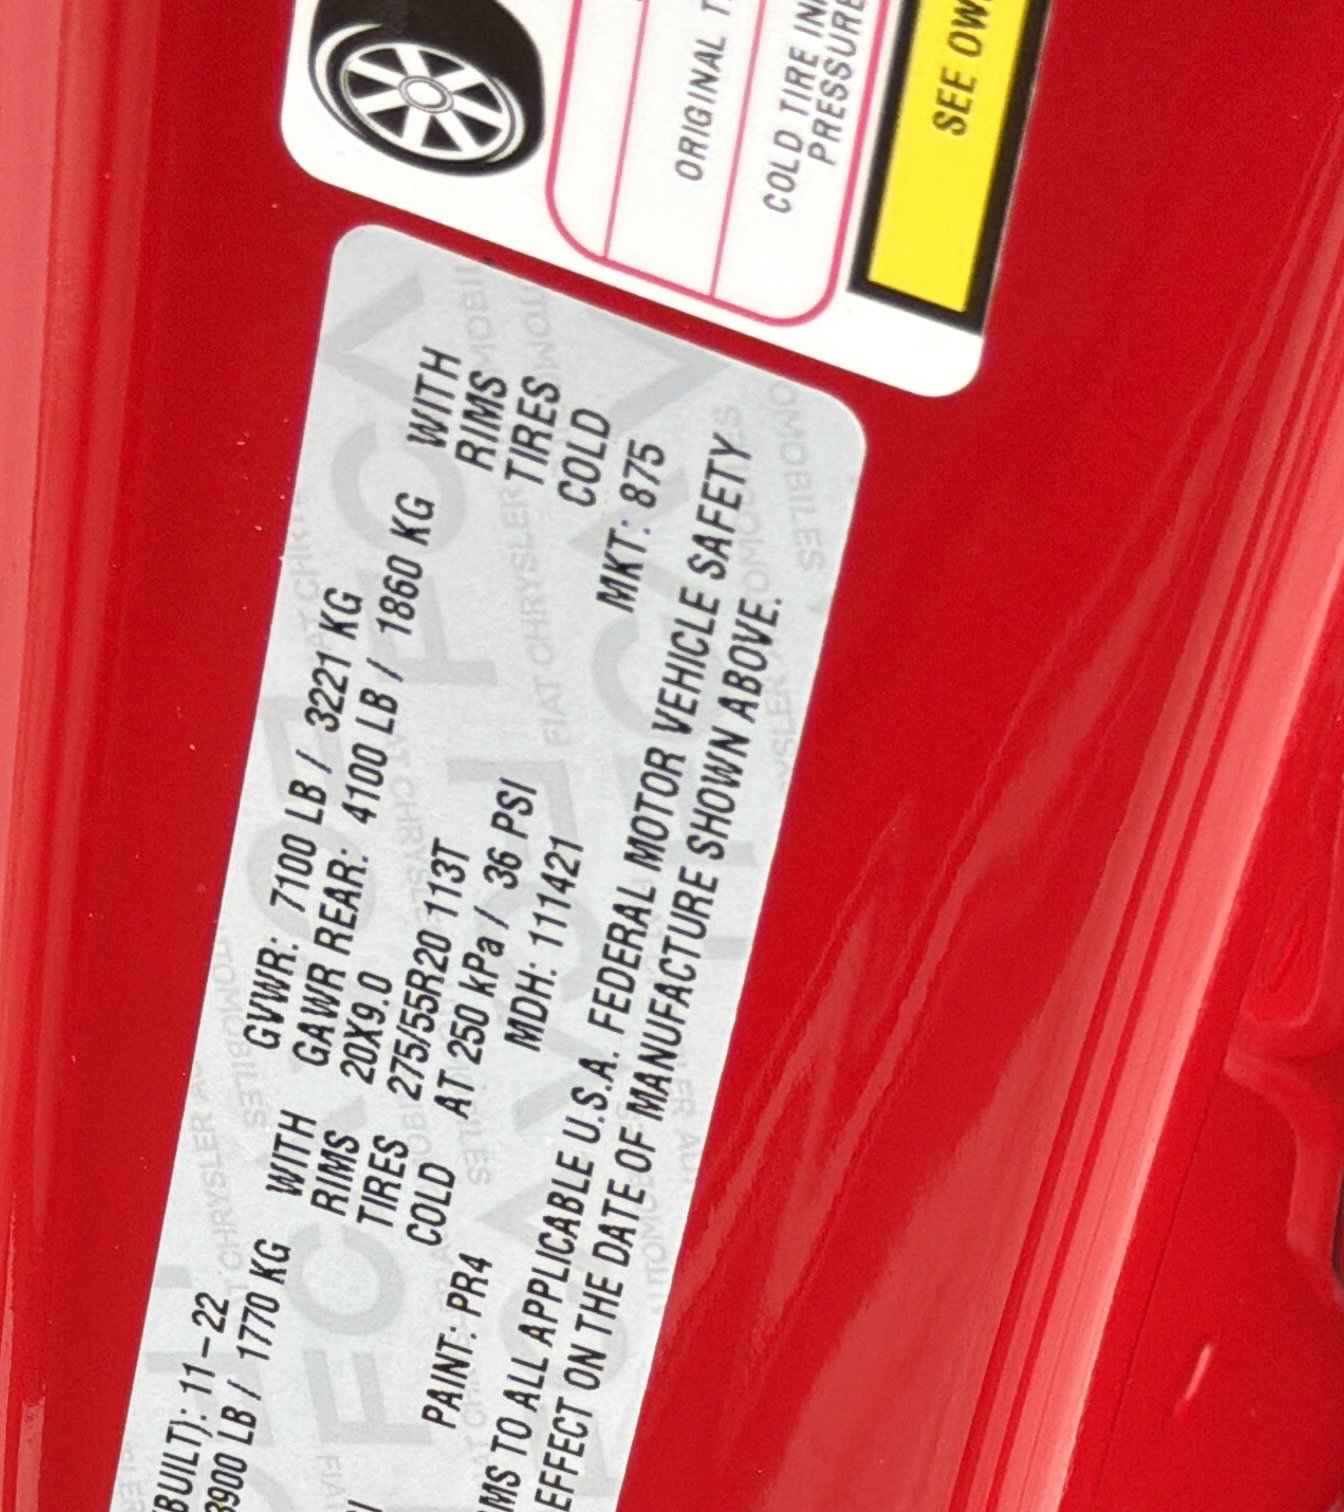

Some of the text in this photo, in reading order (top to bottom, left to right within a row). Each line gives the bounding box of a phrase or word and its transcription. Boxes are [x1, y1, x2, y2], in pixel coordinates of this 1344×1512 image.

[674, 36, 727, 182] ORIGINAL
[762, 0, 828, 214] COLD TIRE IN
[931, 0, 989, 136] SEE OW
[406, 346, 460, 447] WITH
[454, 370, 507, 471] RIMS
[504, 375, 560, 484] TIRES
[557, 408, 610, 506] COLD
[687, 432, 750, 579] SAFETY
[596, 439, 664, 612] MKT: 875
[651, 586, 719, 734] VEHICLE
[717, 598, 780, 723] ABOVE.
[243, 587, 362, 1049] GVWR: 7100 LB / 3221 KG
[292, 492, 434, 1066] GAWR REAR: 4100 LB / 1860 KG
[623, 746, 685, 871] MOTOR
[686, 725, 749, 859] SHOWN
[386, 929, 451, 1100] 275/55R20
[423, 837, 469, 916] 113T
[433, 777, 536, 1119] AT 250 kPa / 36 PSI
[503, 835, 583, 1051] MDH: 111421
[587, 886, 656, 1034] FEDERAL
[625, 865, 717, 1121] MANUFACTURE
[339, 970, 392, 1084] 20X9.0
[265, 1109, 316, 1196] WITH
[562, 1052, 618, 1143] U.S.A.
[614, 1126, 655, 1172] OF
[310, 1129, 359, 1216] RIMS
[356, 1134, 408, 1227] TIRES
[406, 1162, 455, 1245] COLD
[591, 1178, 645, 1266] DATE
[249, 1238, 290, 1284] KG
[517, 1150, 594, 1347] APPLICABLE
[574, 1271, 623, 1335] THE
[236, 1291, 279, 1360] 1770
[421, 1253, 492, 1428] PAINT: PR4
[563, 1343, 606, 1390] ON
[217, 1405, 256, 1445] LB
[227, 1379, 261, 1400] /
[490, 1416, 532, 1455] TO
[503, 1357, 548, 1412] ALL
[534, 1396, 592, 1512] EFFECT
